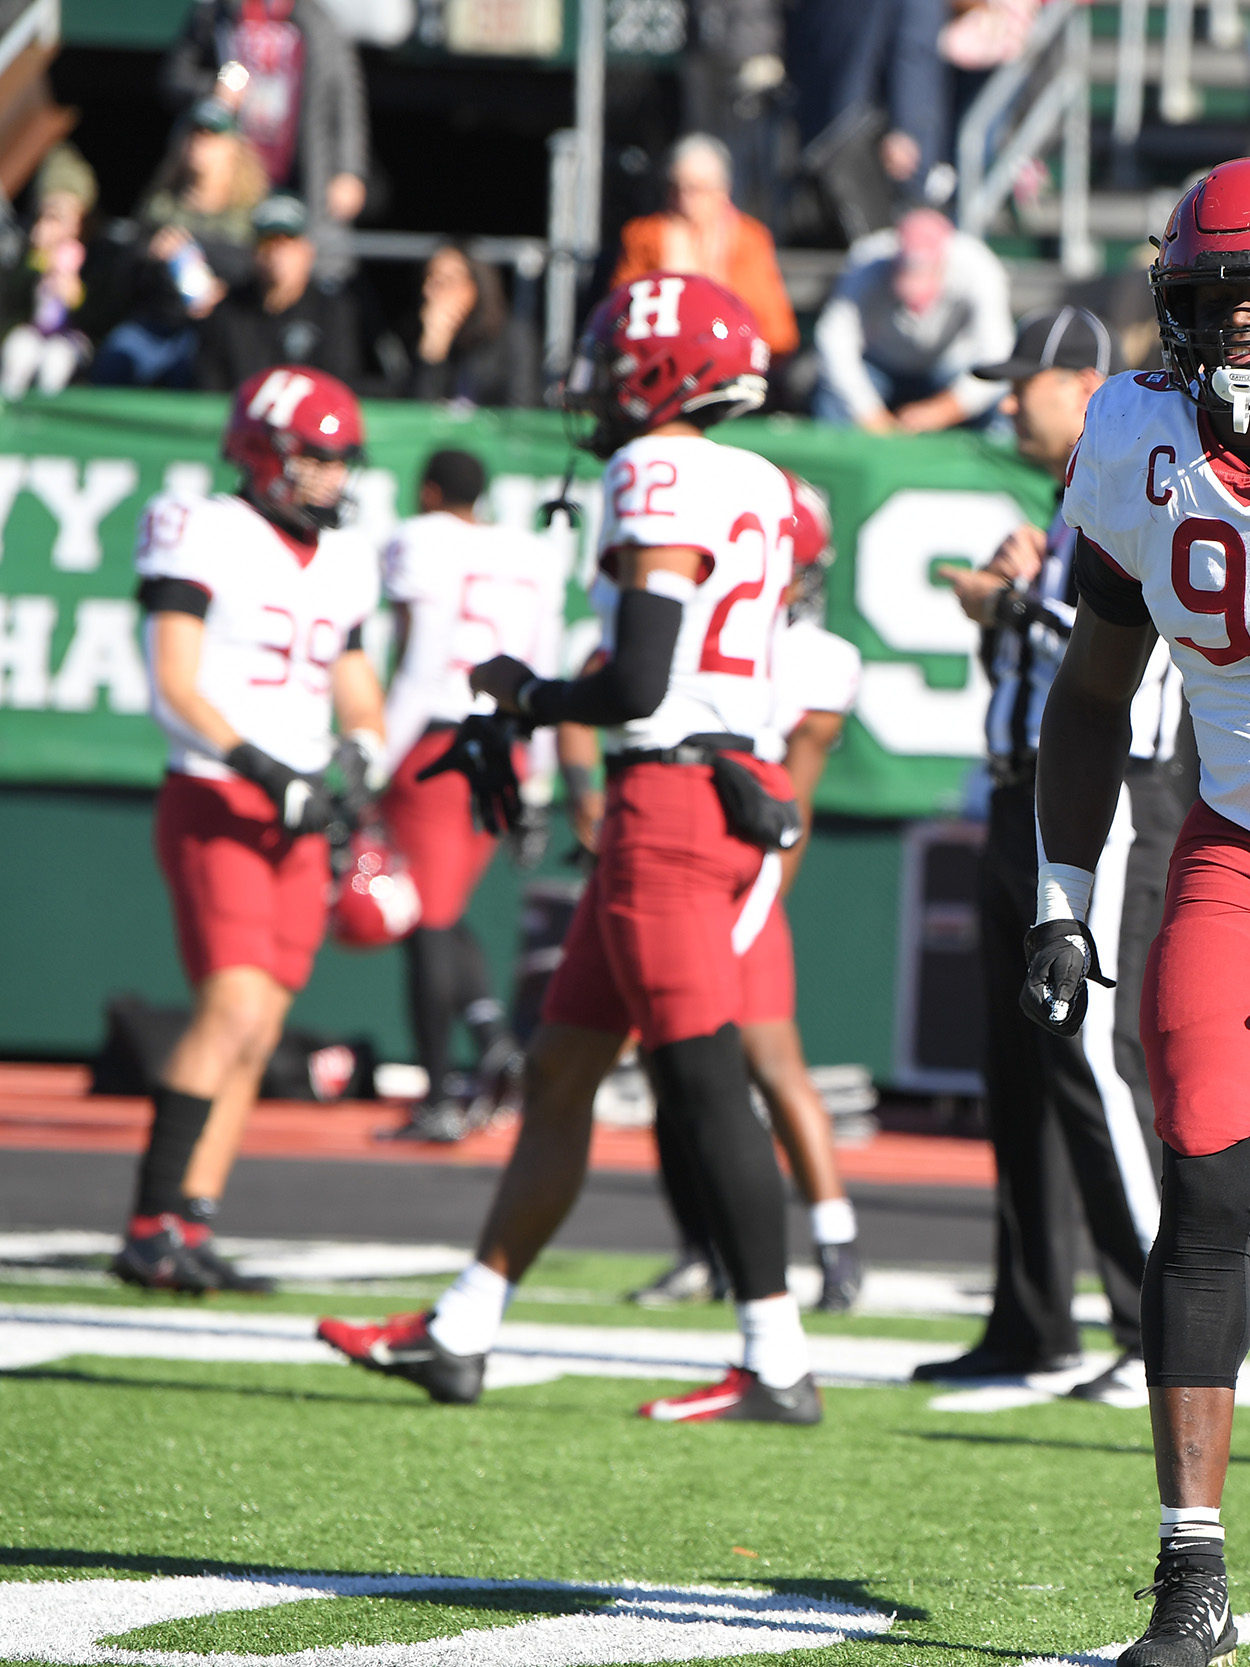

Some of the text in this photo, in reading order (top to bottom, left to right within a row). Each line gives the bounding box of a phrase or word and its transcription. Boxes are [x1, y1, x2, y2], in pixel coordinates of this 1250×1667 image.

[626, 278, 684, 339] H
[247, 368, 315, 428] H
[611, 461, 677, 517] 22
[1146, 445, 1176, 506] C
[247, 604, 337, 694] 39
